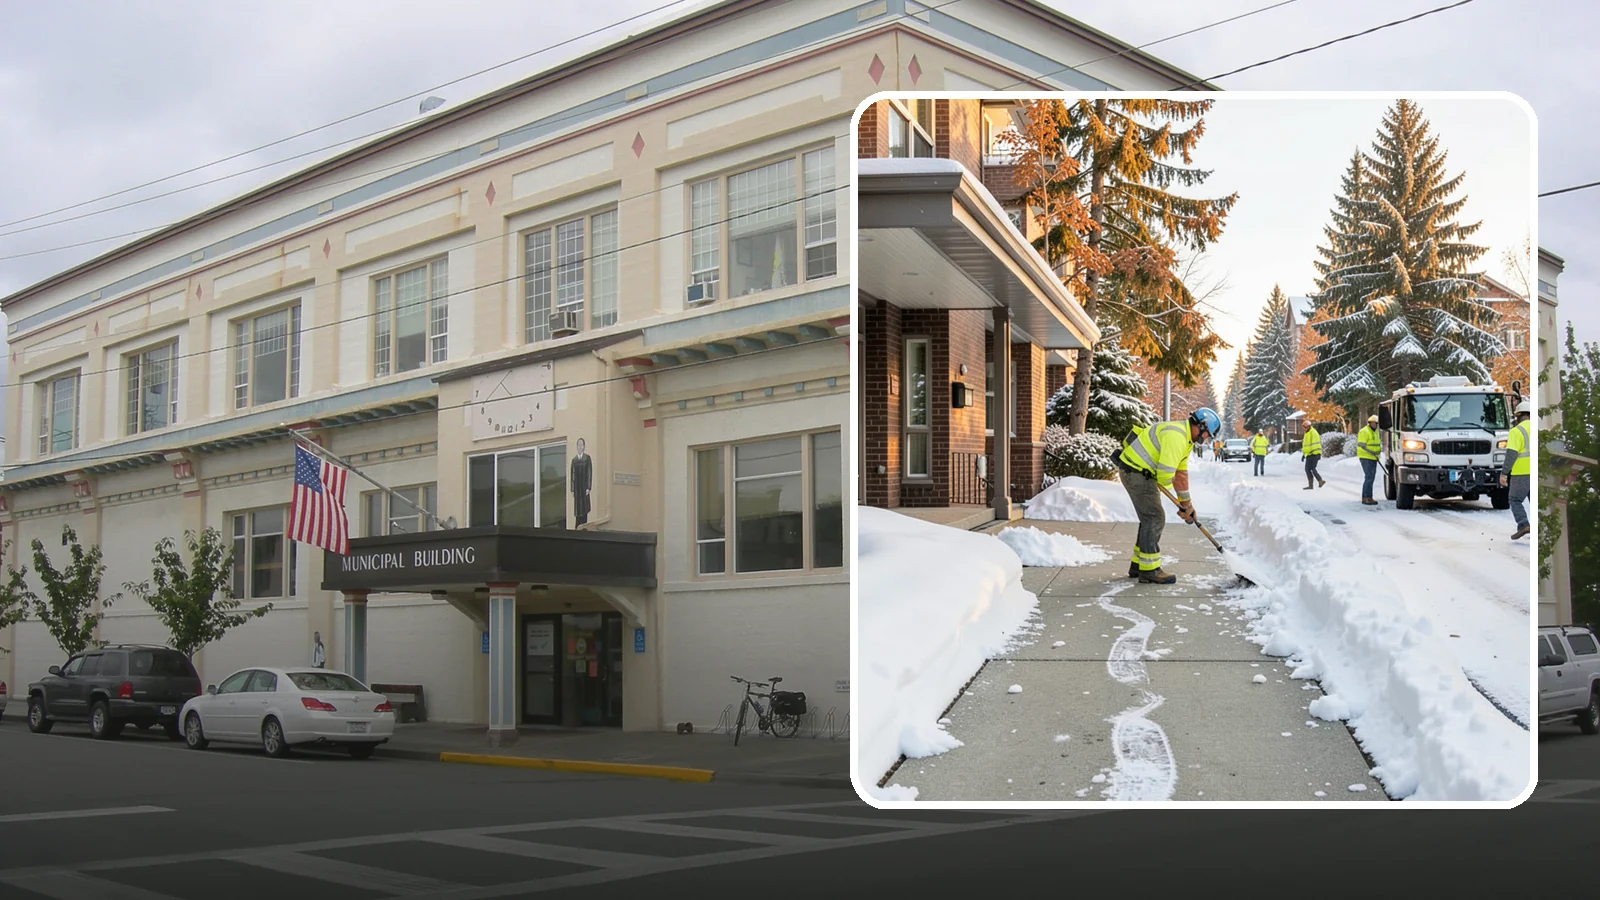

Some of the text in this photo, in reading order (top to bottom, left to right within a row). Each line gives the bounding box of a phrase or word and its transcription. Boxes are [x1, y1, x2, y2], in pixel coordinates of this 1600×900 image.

[475, 390, 479, 398] 7
[536, 402, 540, 410] 4
[481, 407, 485, 415] 8
[488, 418, 492, 426] 9
[529, 414, 533, 422] 3
[342, 546, 475, 572] MUNICIPAL BUILDING
